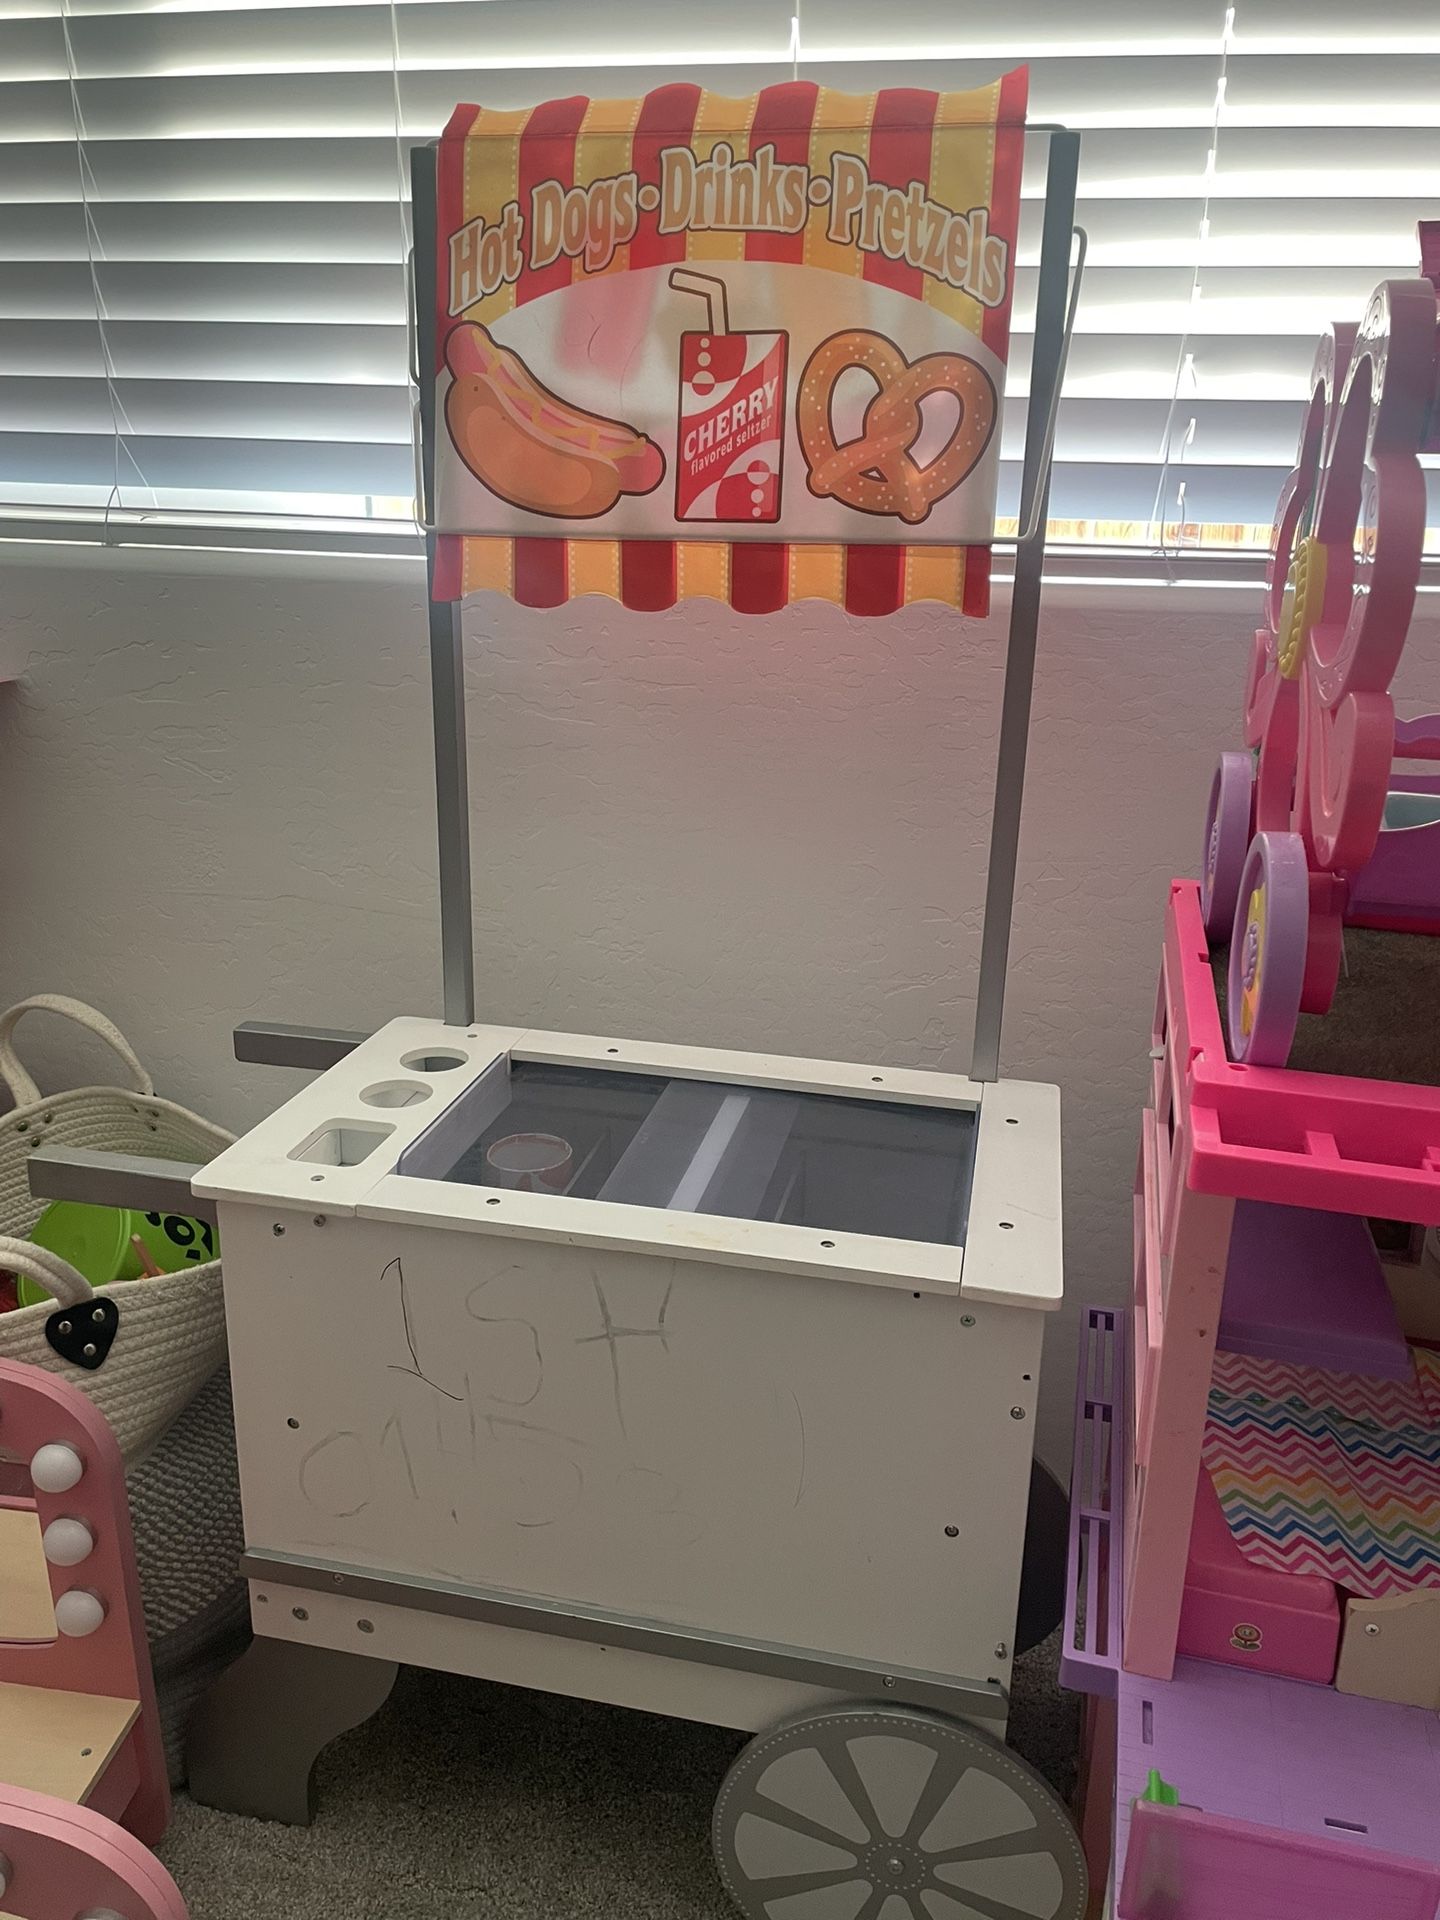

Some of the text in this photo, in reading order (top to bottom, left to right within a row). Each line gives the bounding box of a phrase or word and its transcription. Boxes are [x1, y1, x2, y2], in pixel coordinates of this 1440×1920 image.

[449, 143, 1008, 316] Hot Dogs Drinks Pretzels
[683, 376, 779, 461] CHERRY
[690, 415, 772, 476] flavored seltzer
